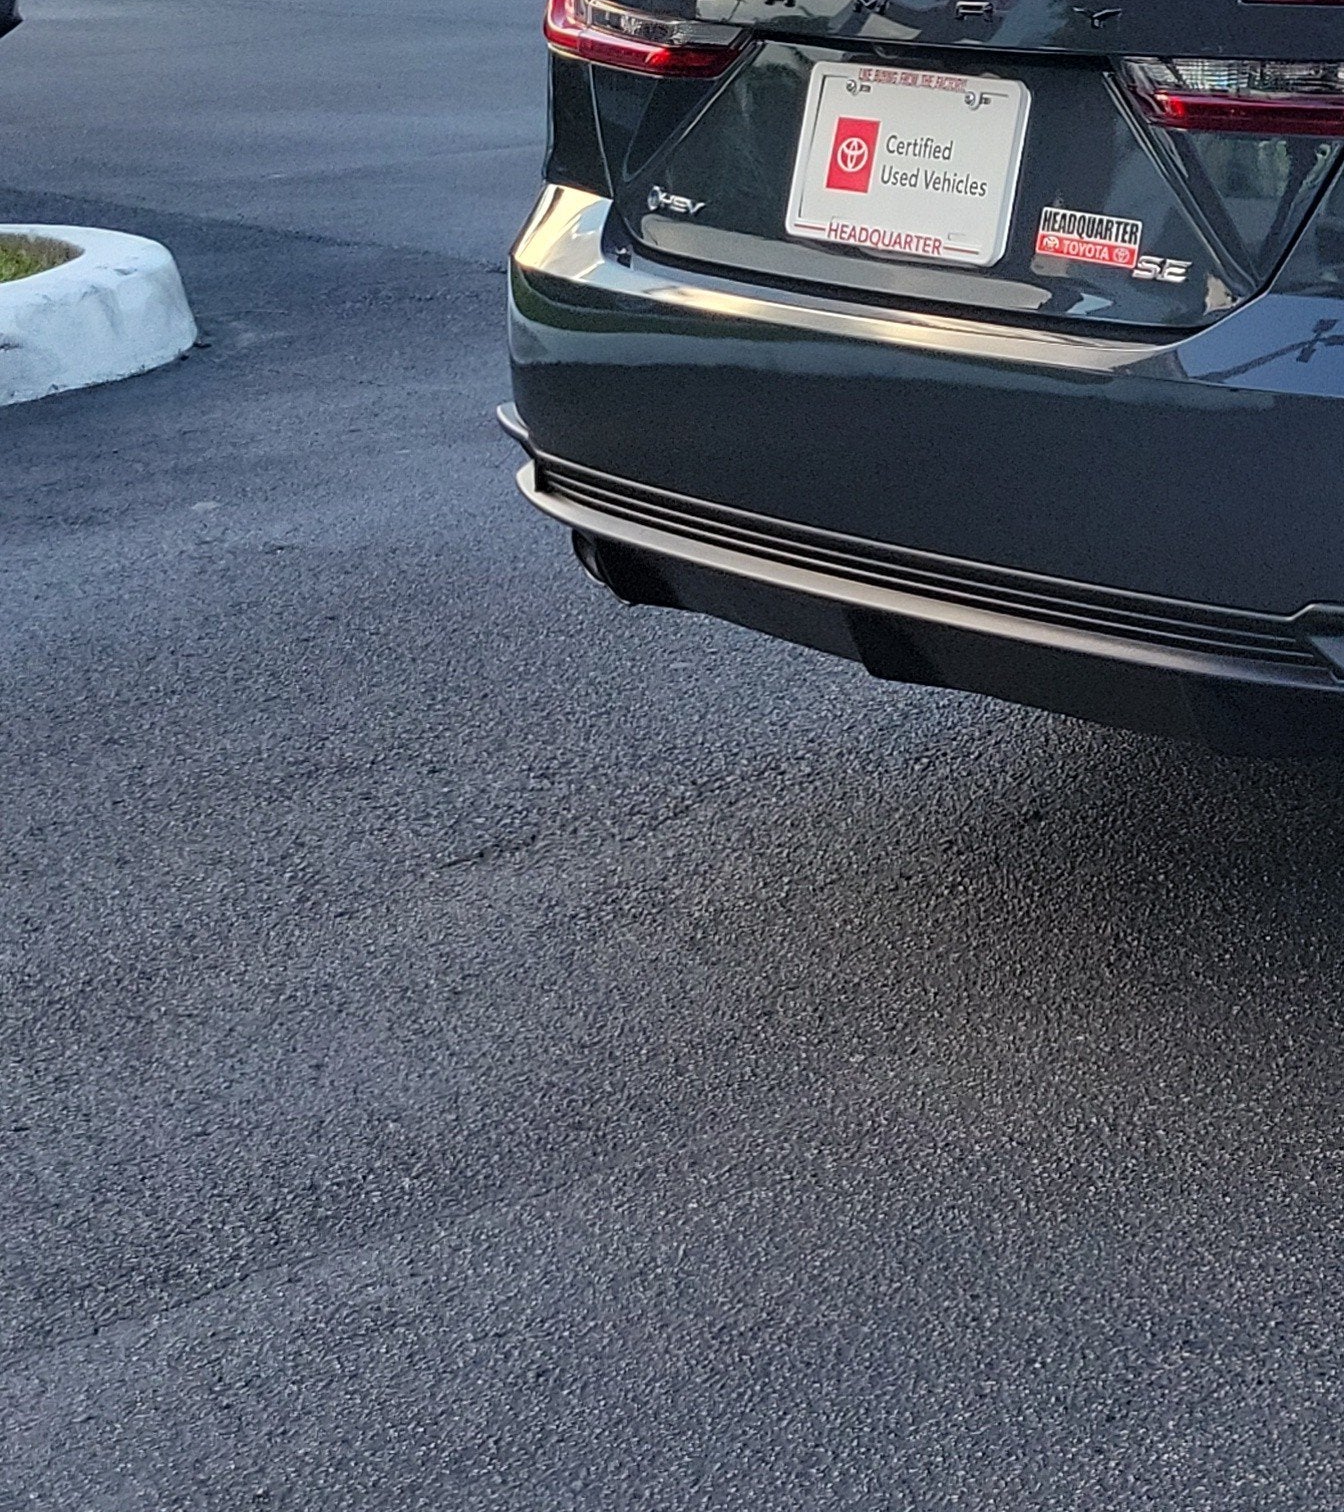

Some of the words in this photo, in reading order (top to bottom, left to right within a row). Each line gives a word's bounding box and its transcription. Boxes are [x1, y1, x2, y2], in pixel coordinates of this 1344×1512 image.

[886, 131, 955, 163] Certified
[880, 164, 921, 190] Used
[924, 167, 988, 198] Vehicles
[827, 219, 943, 258] HEADQUARTER
[1041, 209, 1140, 246] HEADQUARTER
[1062, 240, 1111, 261] TOYOTA
[1131, 254, 1194, 284] SE
